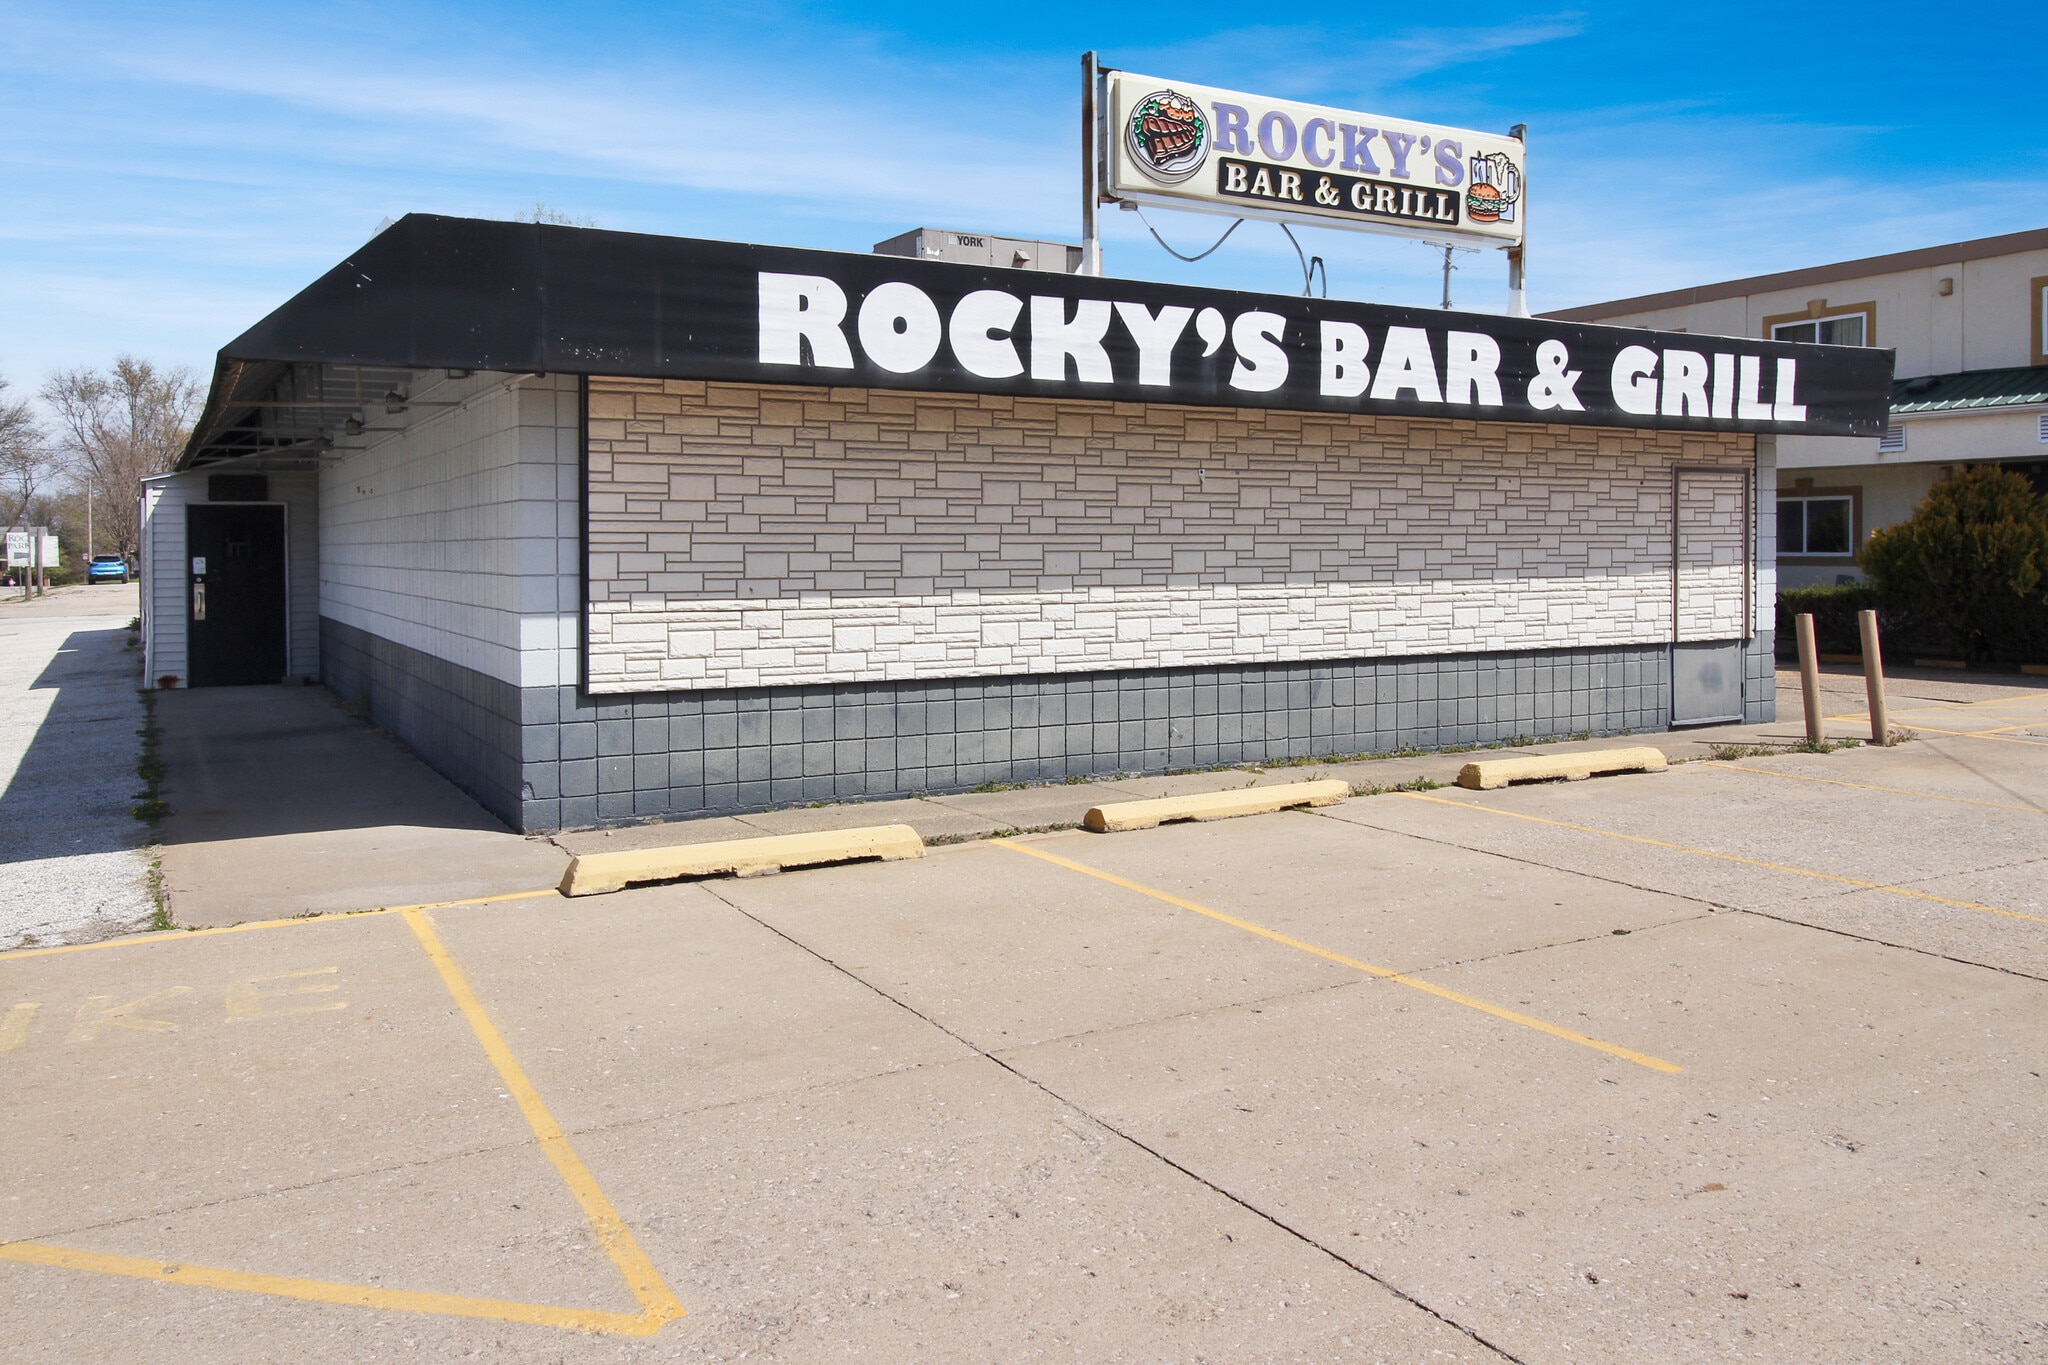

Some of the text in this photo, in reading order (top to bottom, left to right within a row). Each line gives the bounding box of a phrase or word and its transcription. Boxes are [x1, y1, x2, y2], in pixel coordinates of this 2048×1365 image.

[1212, 102, 1464, 186] ROCKY'S
[1225, 163, 1455, 221] BAR & GRILL
[957, 235, 983, 248] YORK
[758, 271, 1807, 421] ROCKY'S BAR & GRILL
